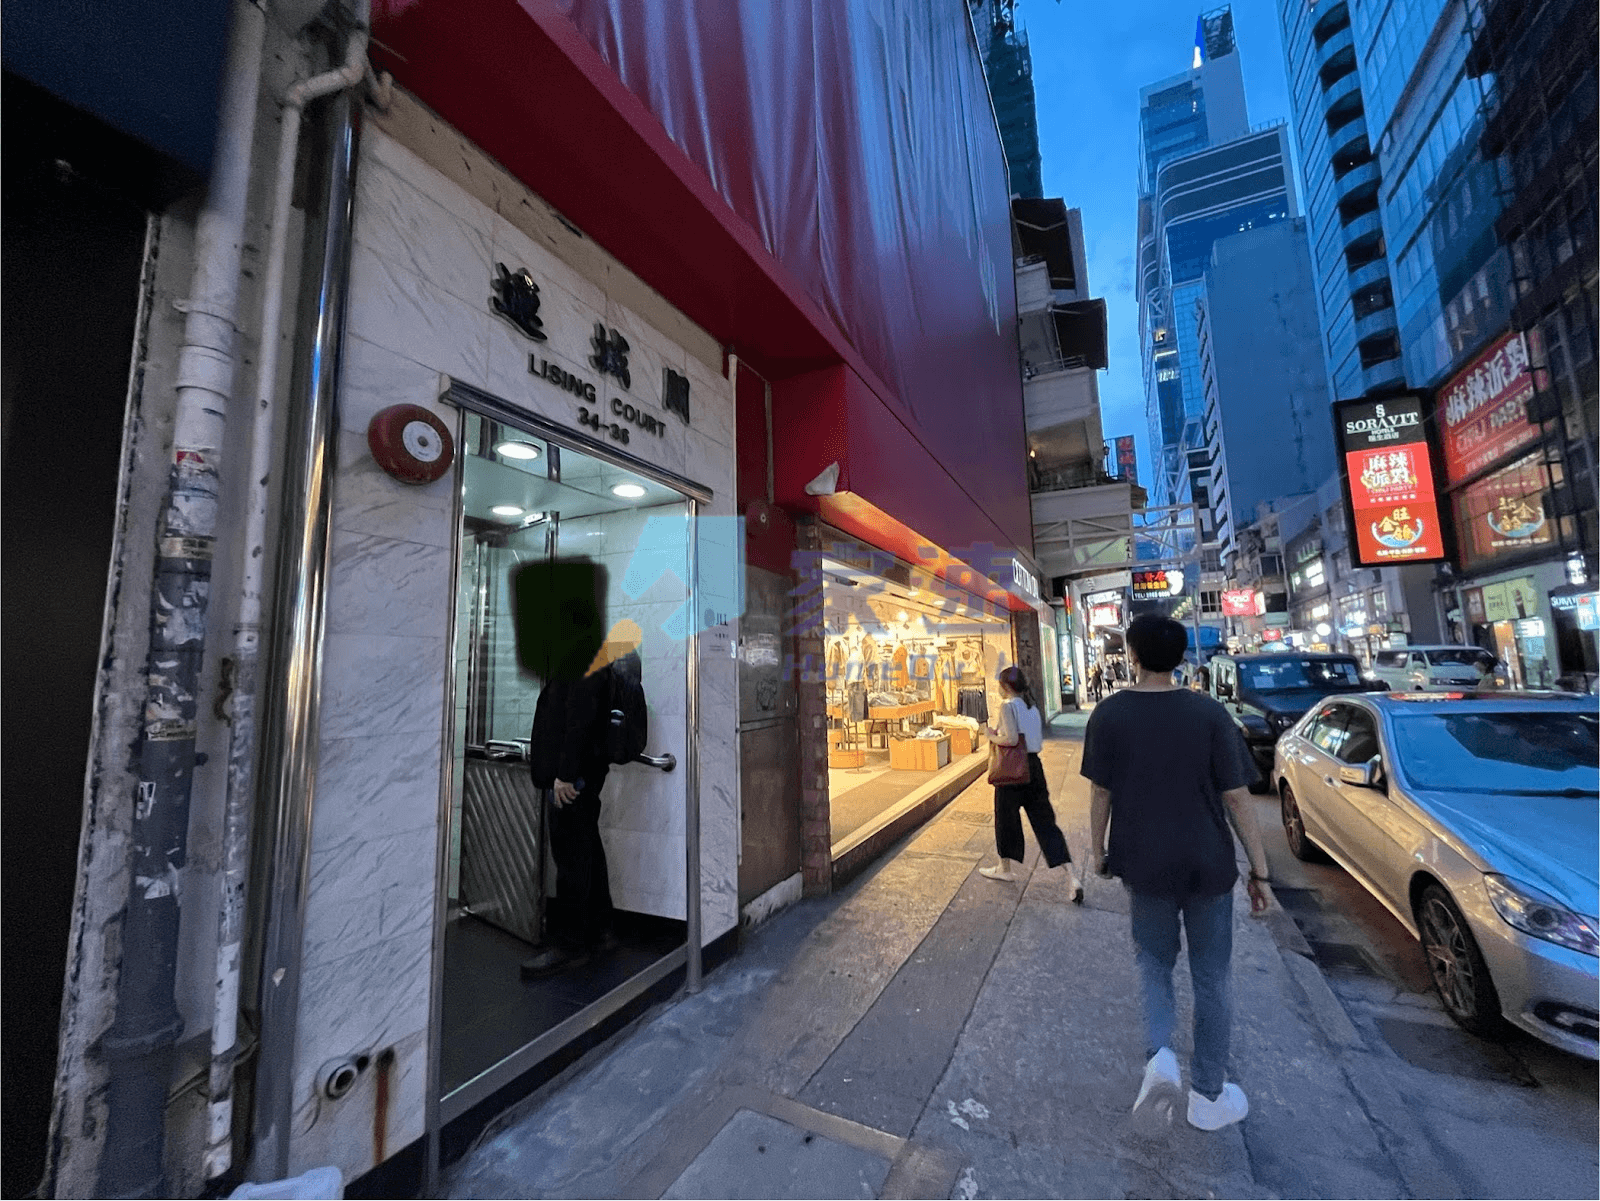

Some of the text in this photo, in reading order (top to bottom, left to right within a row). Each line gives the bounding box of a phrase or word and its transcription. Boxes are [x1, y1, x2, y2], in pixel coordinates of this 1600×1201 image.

[528, 353, 667, 437] LISING COURT
[577, 407, 630, 446] 34-36
[1346, 412, 1419, 433] SORAVIT
